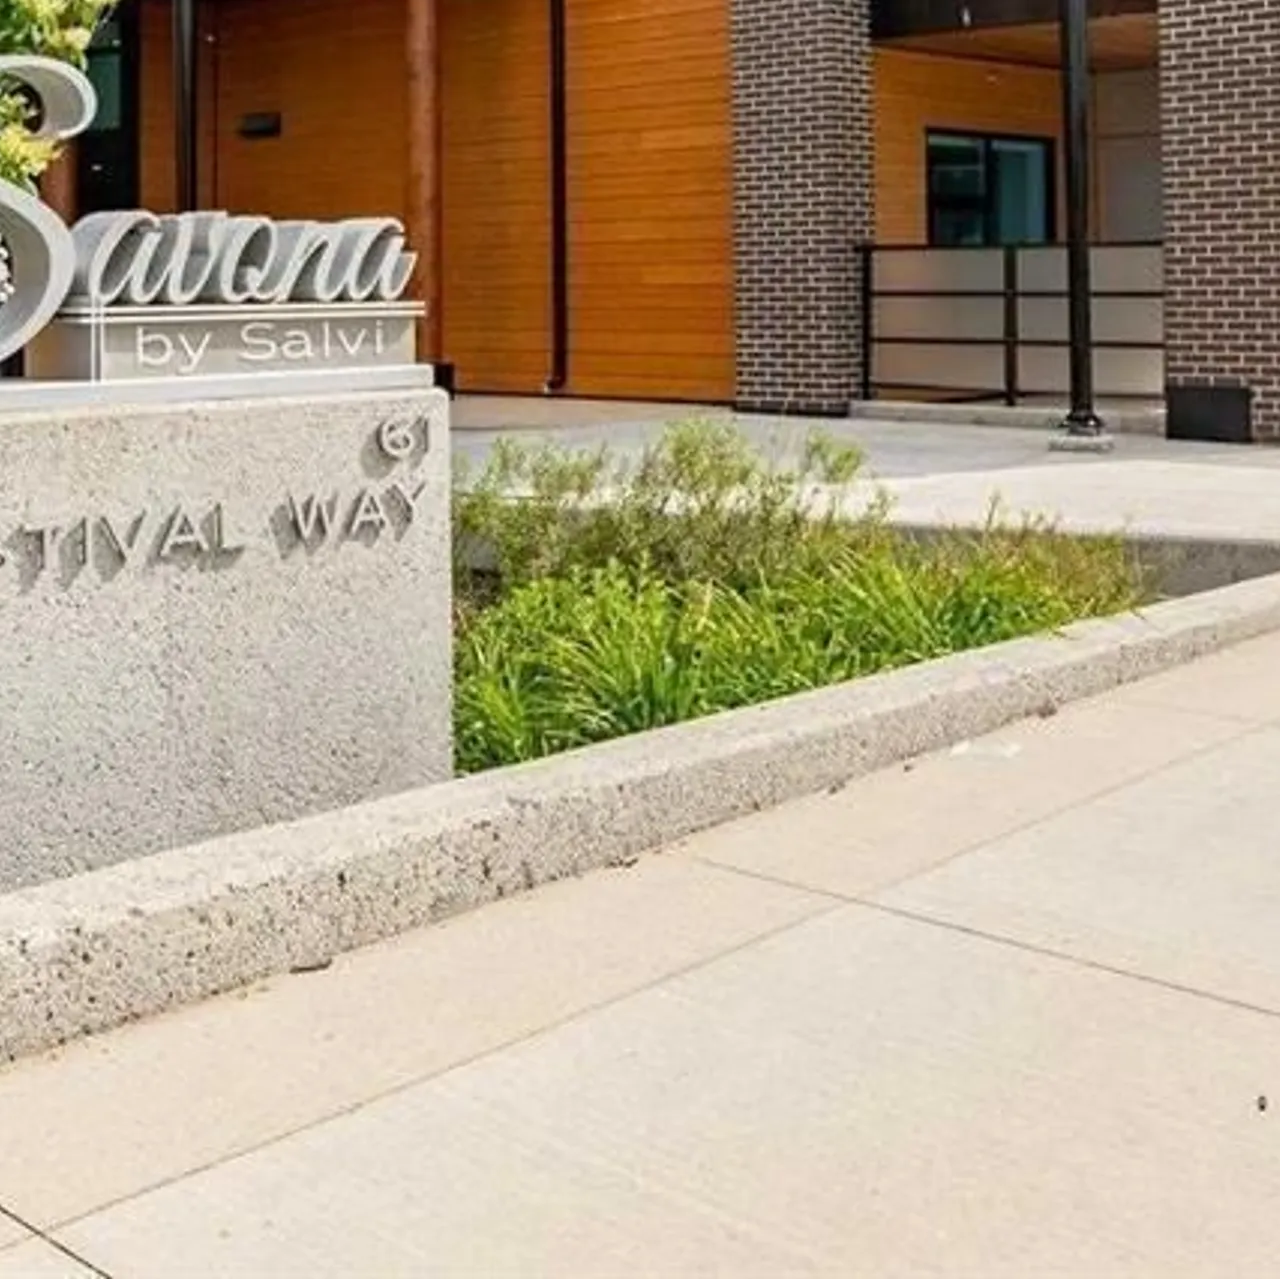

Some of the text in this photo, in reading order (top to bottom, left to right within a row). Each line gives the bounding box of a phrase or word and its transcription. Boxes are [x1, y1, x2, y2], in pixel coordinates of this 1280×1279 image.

[135, 321, 387, 372] by Salvi
[286, 482, 427, 545] WAY
